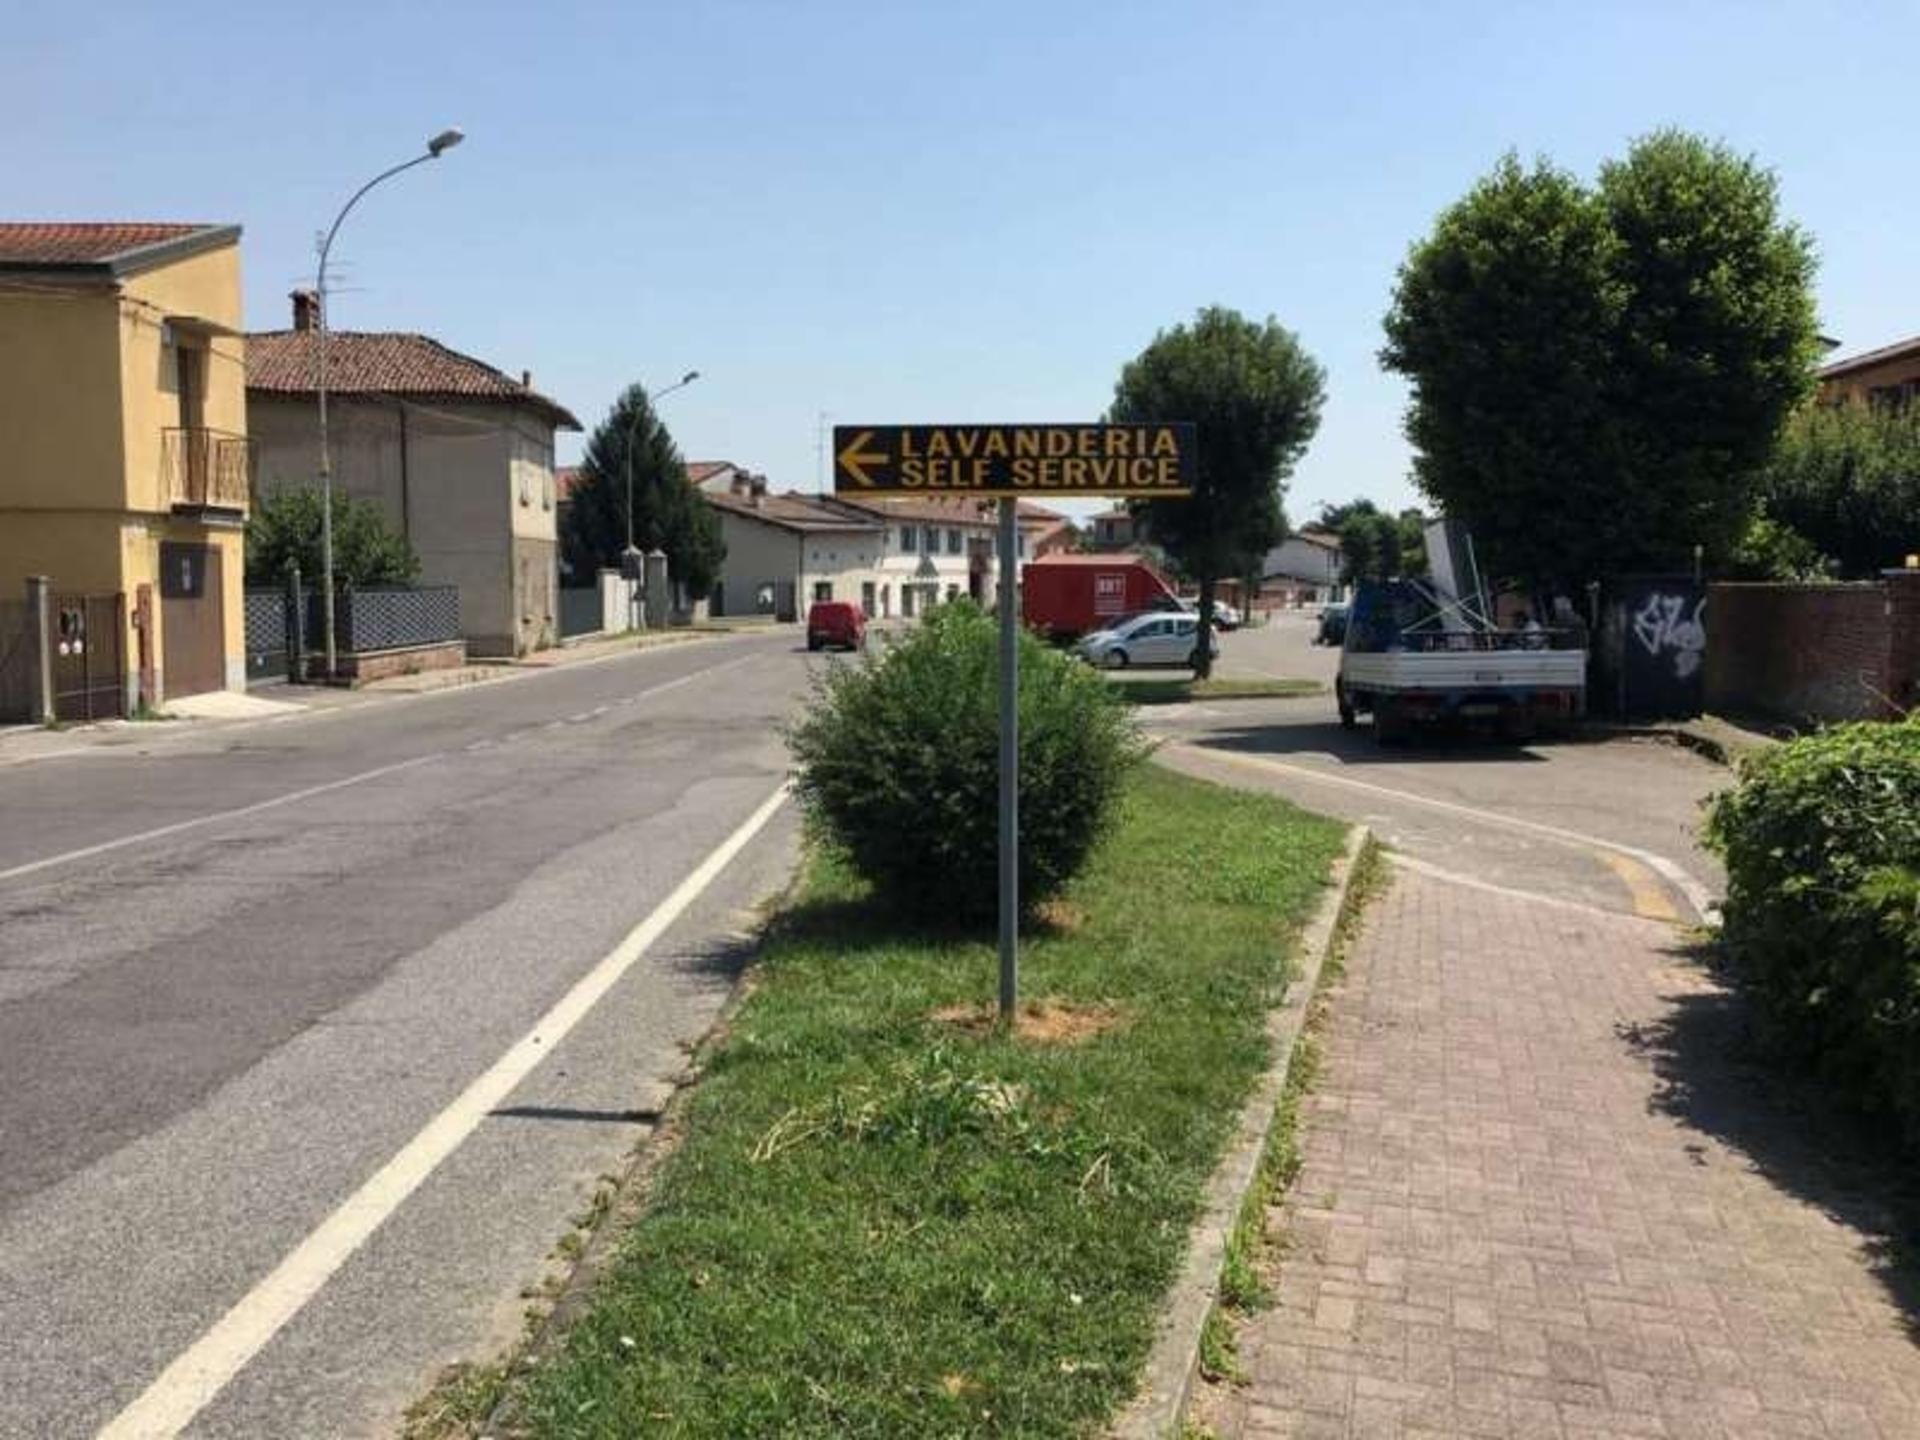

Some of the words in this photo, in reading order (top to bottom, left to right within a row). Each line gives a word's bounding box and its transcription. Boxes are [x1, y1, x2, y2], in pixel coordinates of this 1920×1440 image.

[902, 429, 1178, 458] LAVANDERIA
[902, 459, 991, 487] SELF
[1012, 458, 1179, 486] SERVICE
